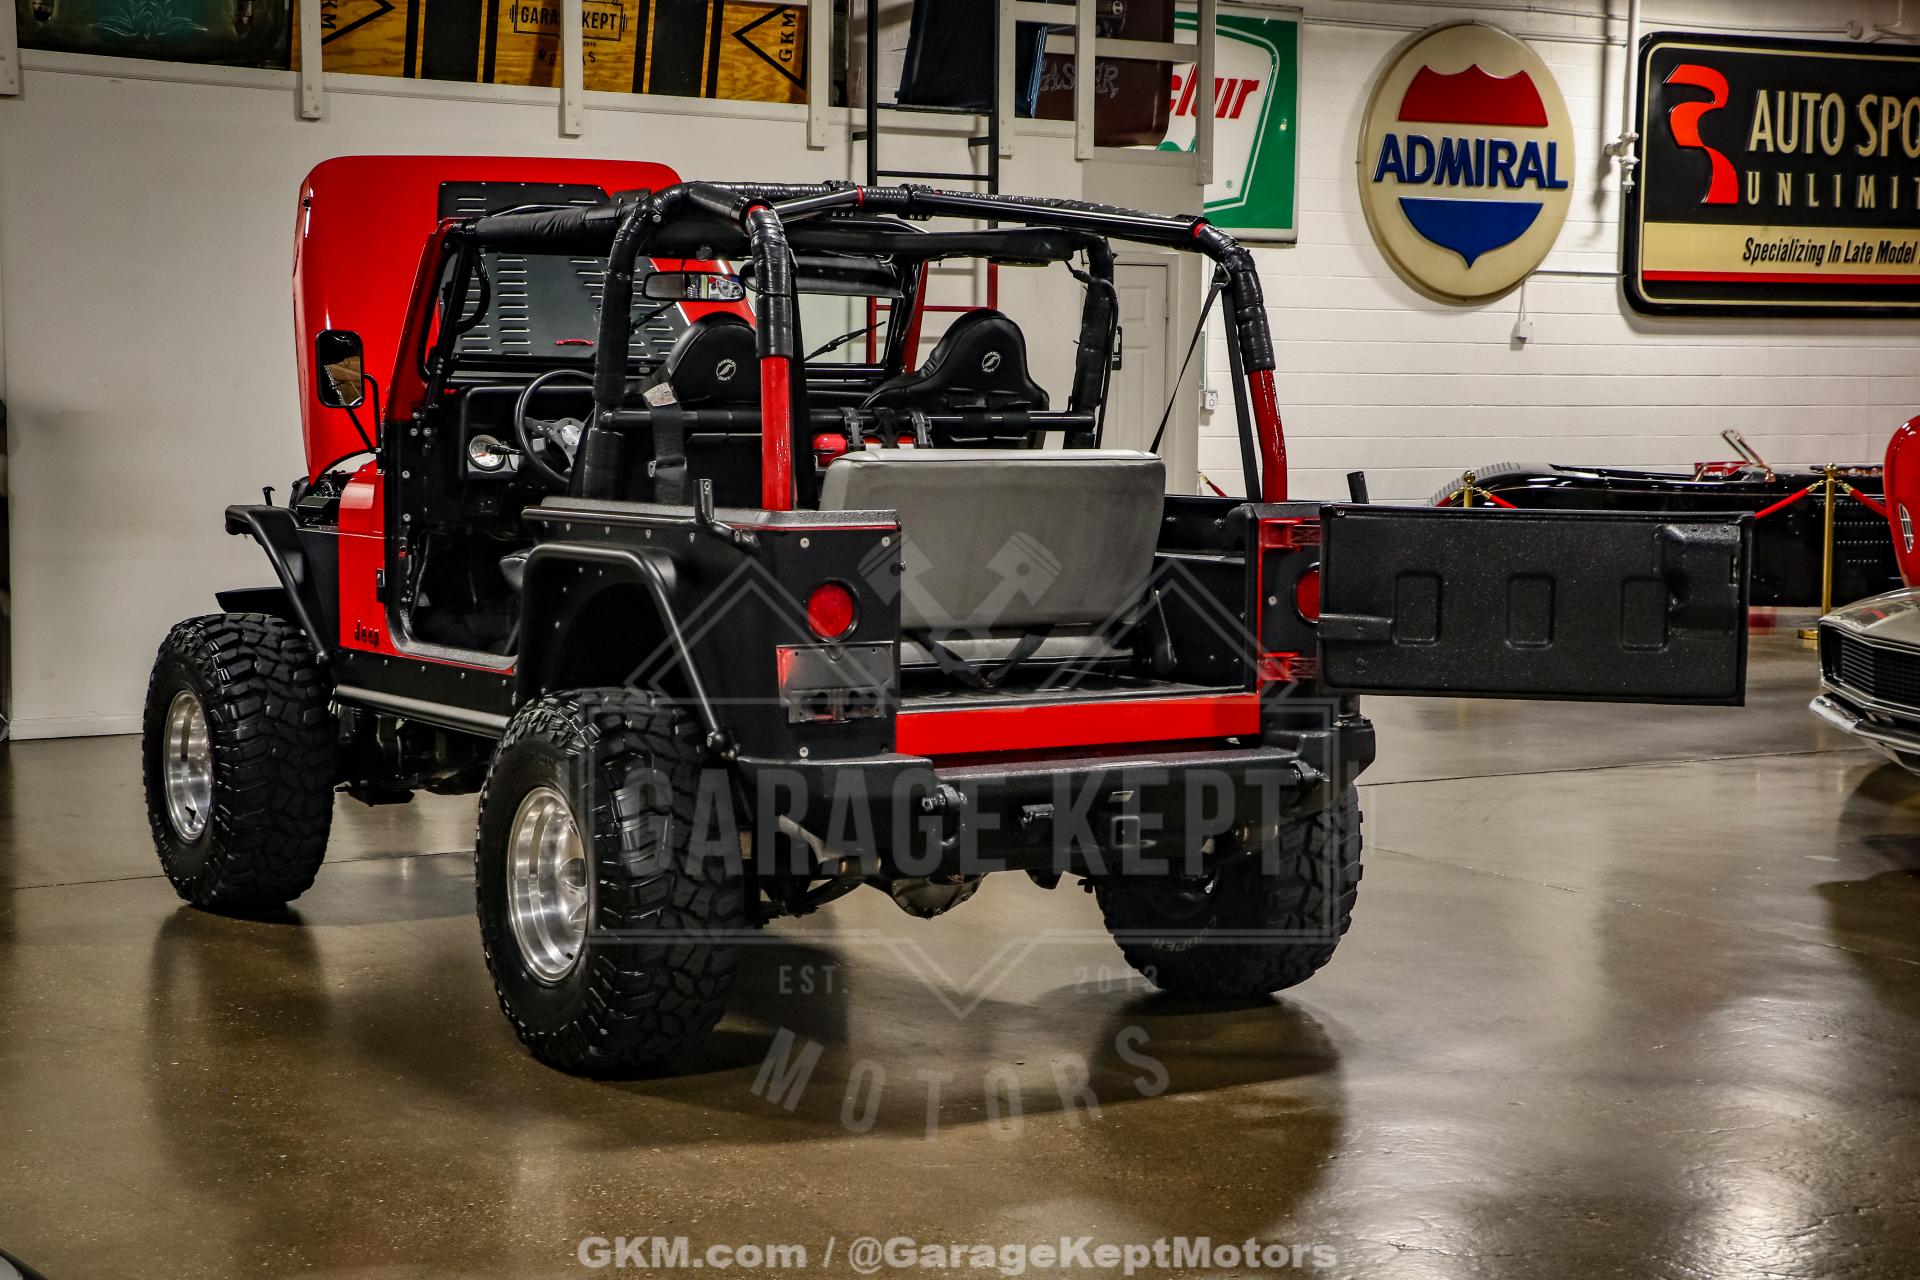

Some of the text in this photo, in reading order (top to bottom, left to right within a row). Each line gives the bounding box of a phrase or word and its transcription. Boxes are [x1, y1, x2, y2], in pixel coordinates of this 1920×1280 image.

[520, 6, 617, 30] GARA KEPT
[779, 13, 797, 62] GKM
[1747, 89, 1920, 159] AUTO SPO
[1373, 133, 1569, 189] ADMIRAL
[1743, 237, 1919, 267] Specializing In Late Model
